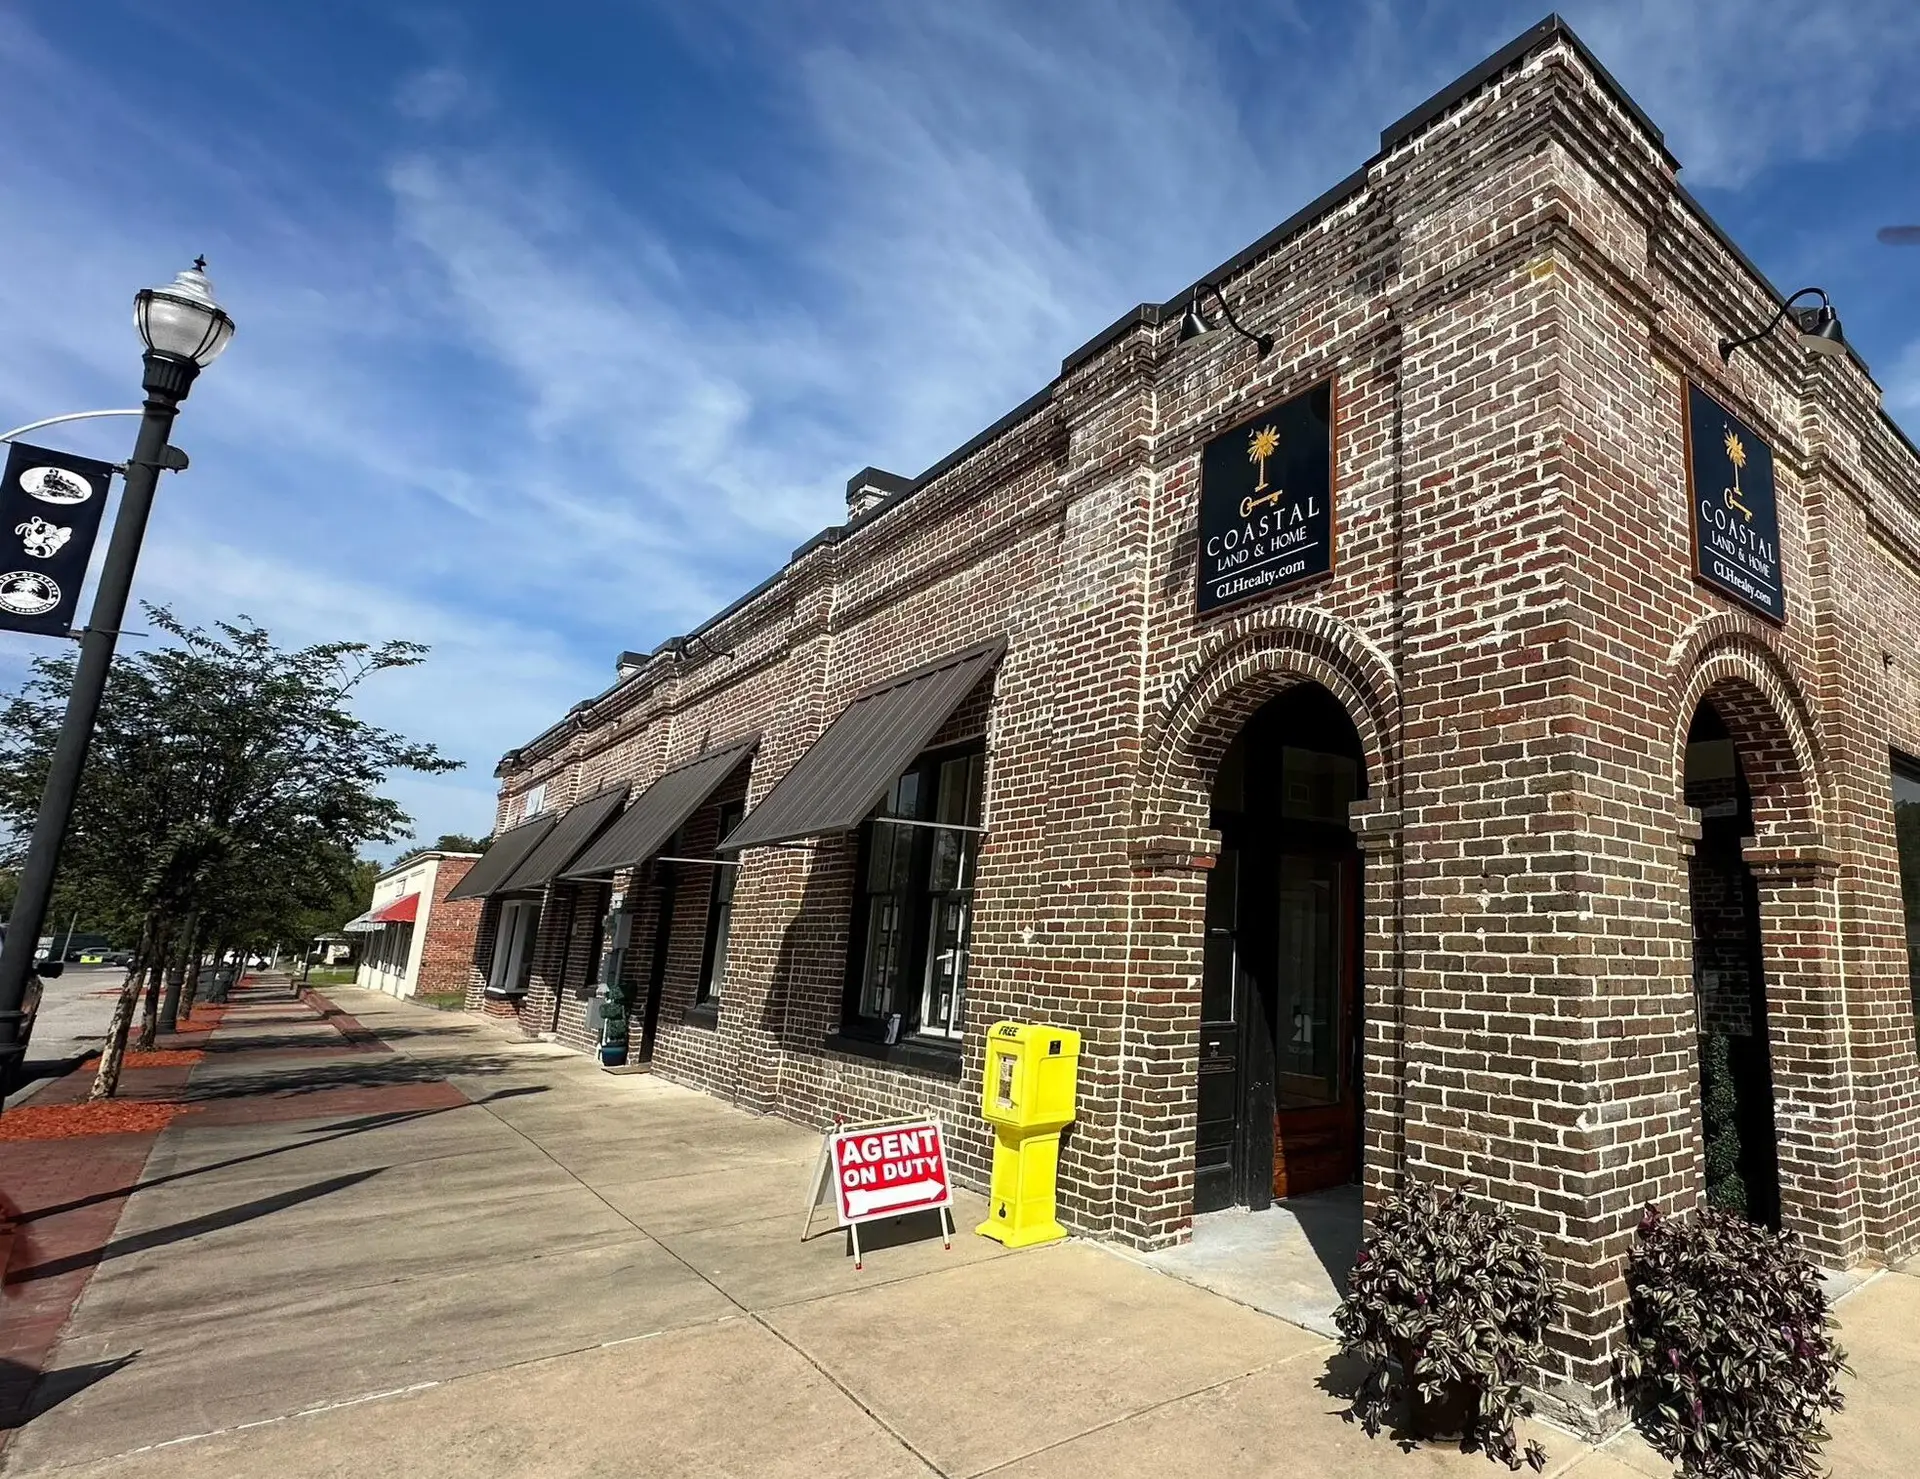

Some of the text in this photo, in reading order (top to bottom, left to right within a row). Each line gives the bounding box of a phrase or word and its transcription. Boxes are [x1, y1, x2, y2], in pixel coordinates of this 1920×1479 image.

[1207, 496, 1320, 557] COASTAL
[1216, 525, 1308, 572] LAND & HOME
[1701, 499, 1776, 565] COASTAL
[1711, 530, 1771, 578] LAND & HOME
[1216, 558, 1305, 599] CLHrealty.com
[1713, 559, 1772, 606] CLHrealty.com
[998, 1026, 1019, 1037] FREE
[842, 1129, 936, 1167] AGENT
[843, 1155, 940, 1188] ON DUTY
